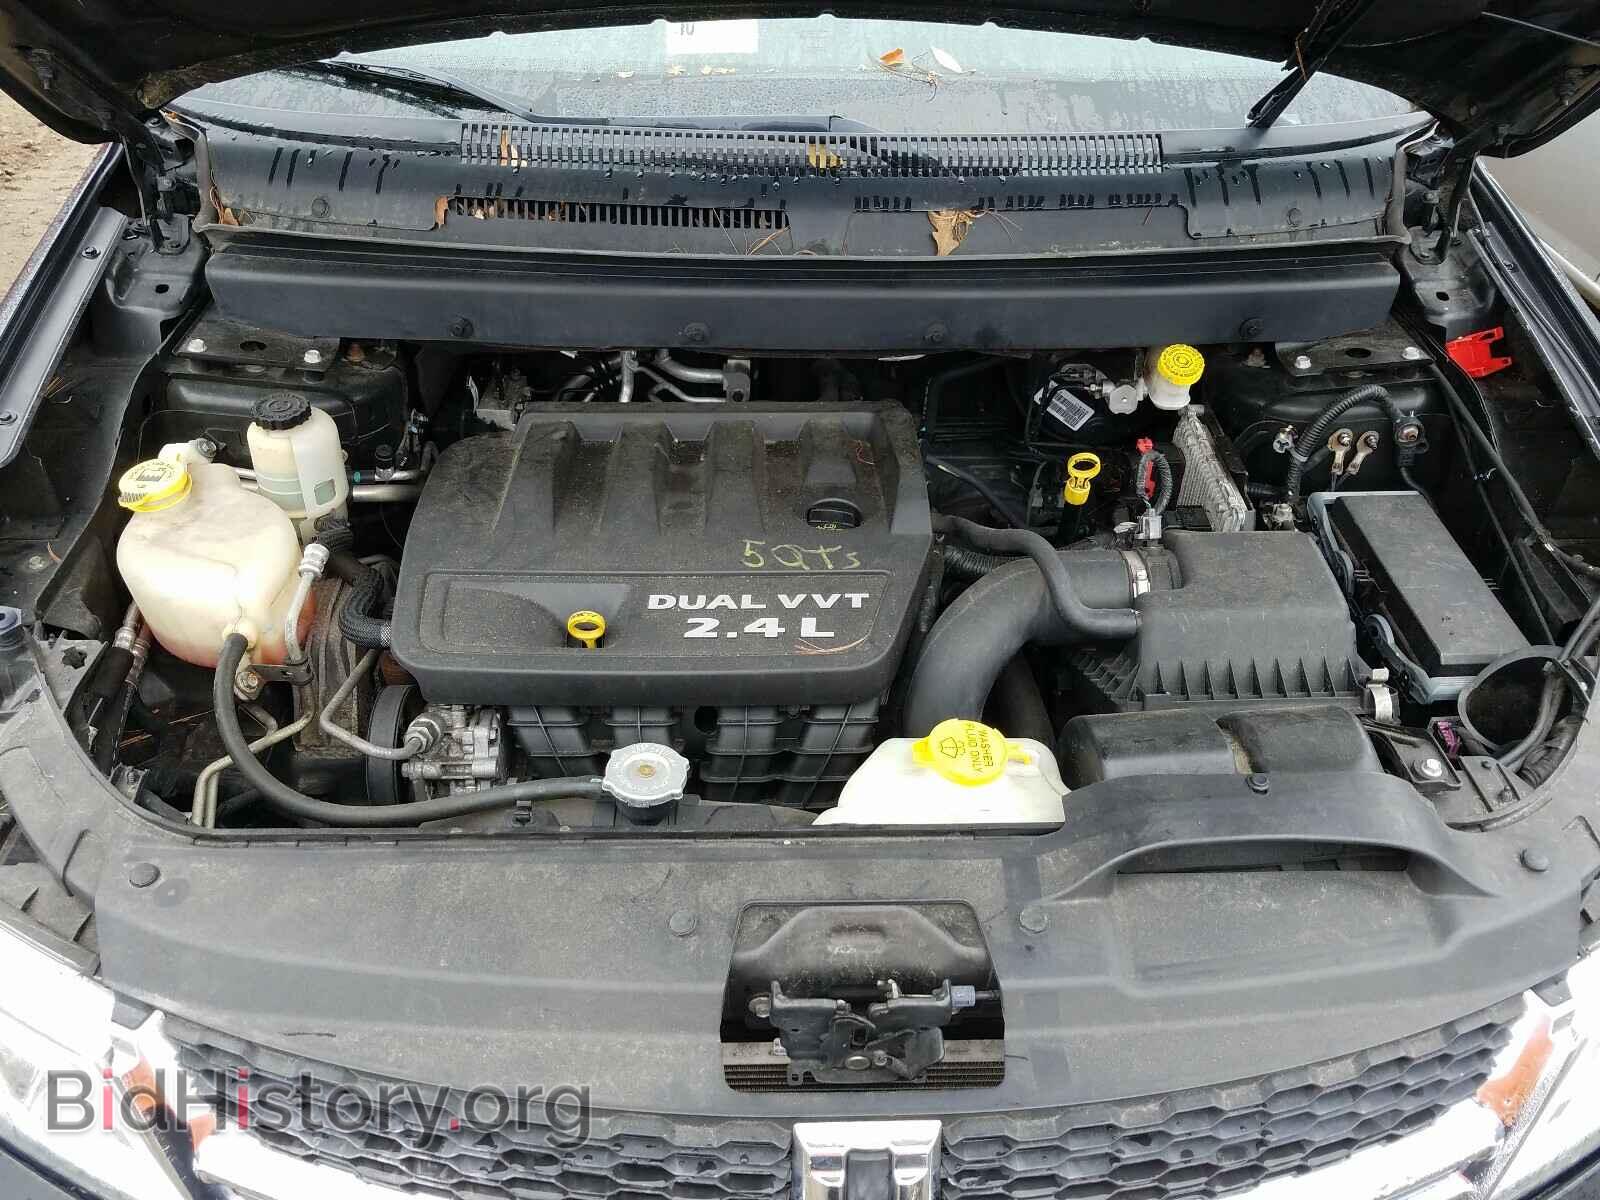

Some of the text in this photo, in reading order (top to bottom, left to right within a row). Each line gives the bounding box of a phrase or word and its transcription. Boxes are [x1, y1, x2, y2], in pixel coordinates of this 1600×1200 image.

[647, 592, 870, 610] DUAL VVT
[966, 723, 983, 773] FLUID ONLY
[978, 729, 994, 767] WASHER
